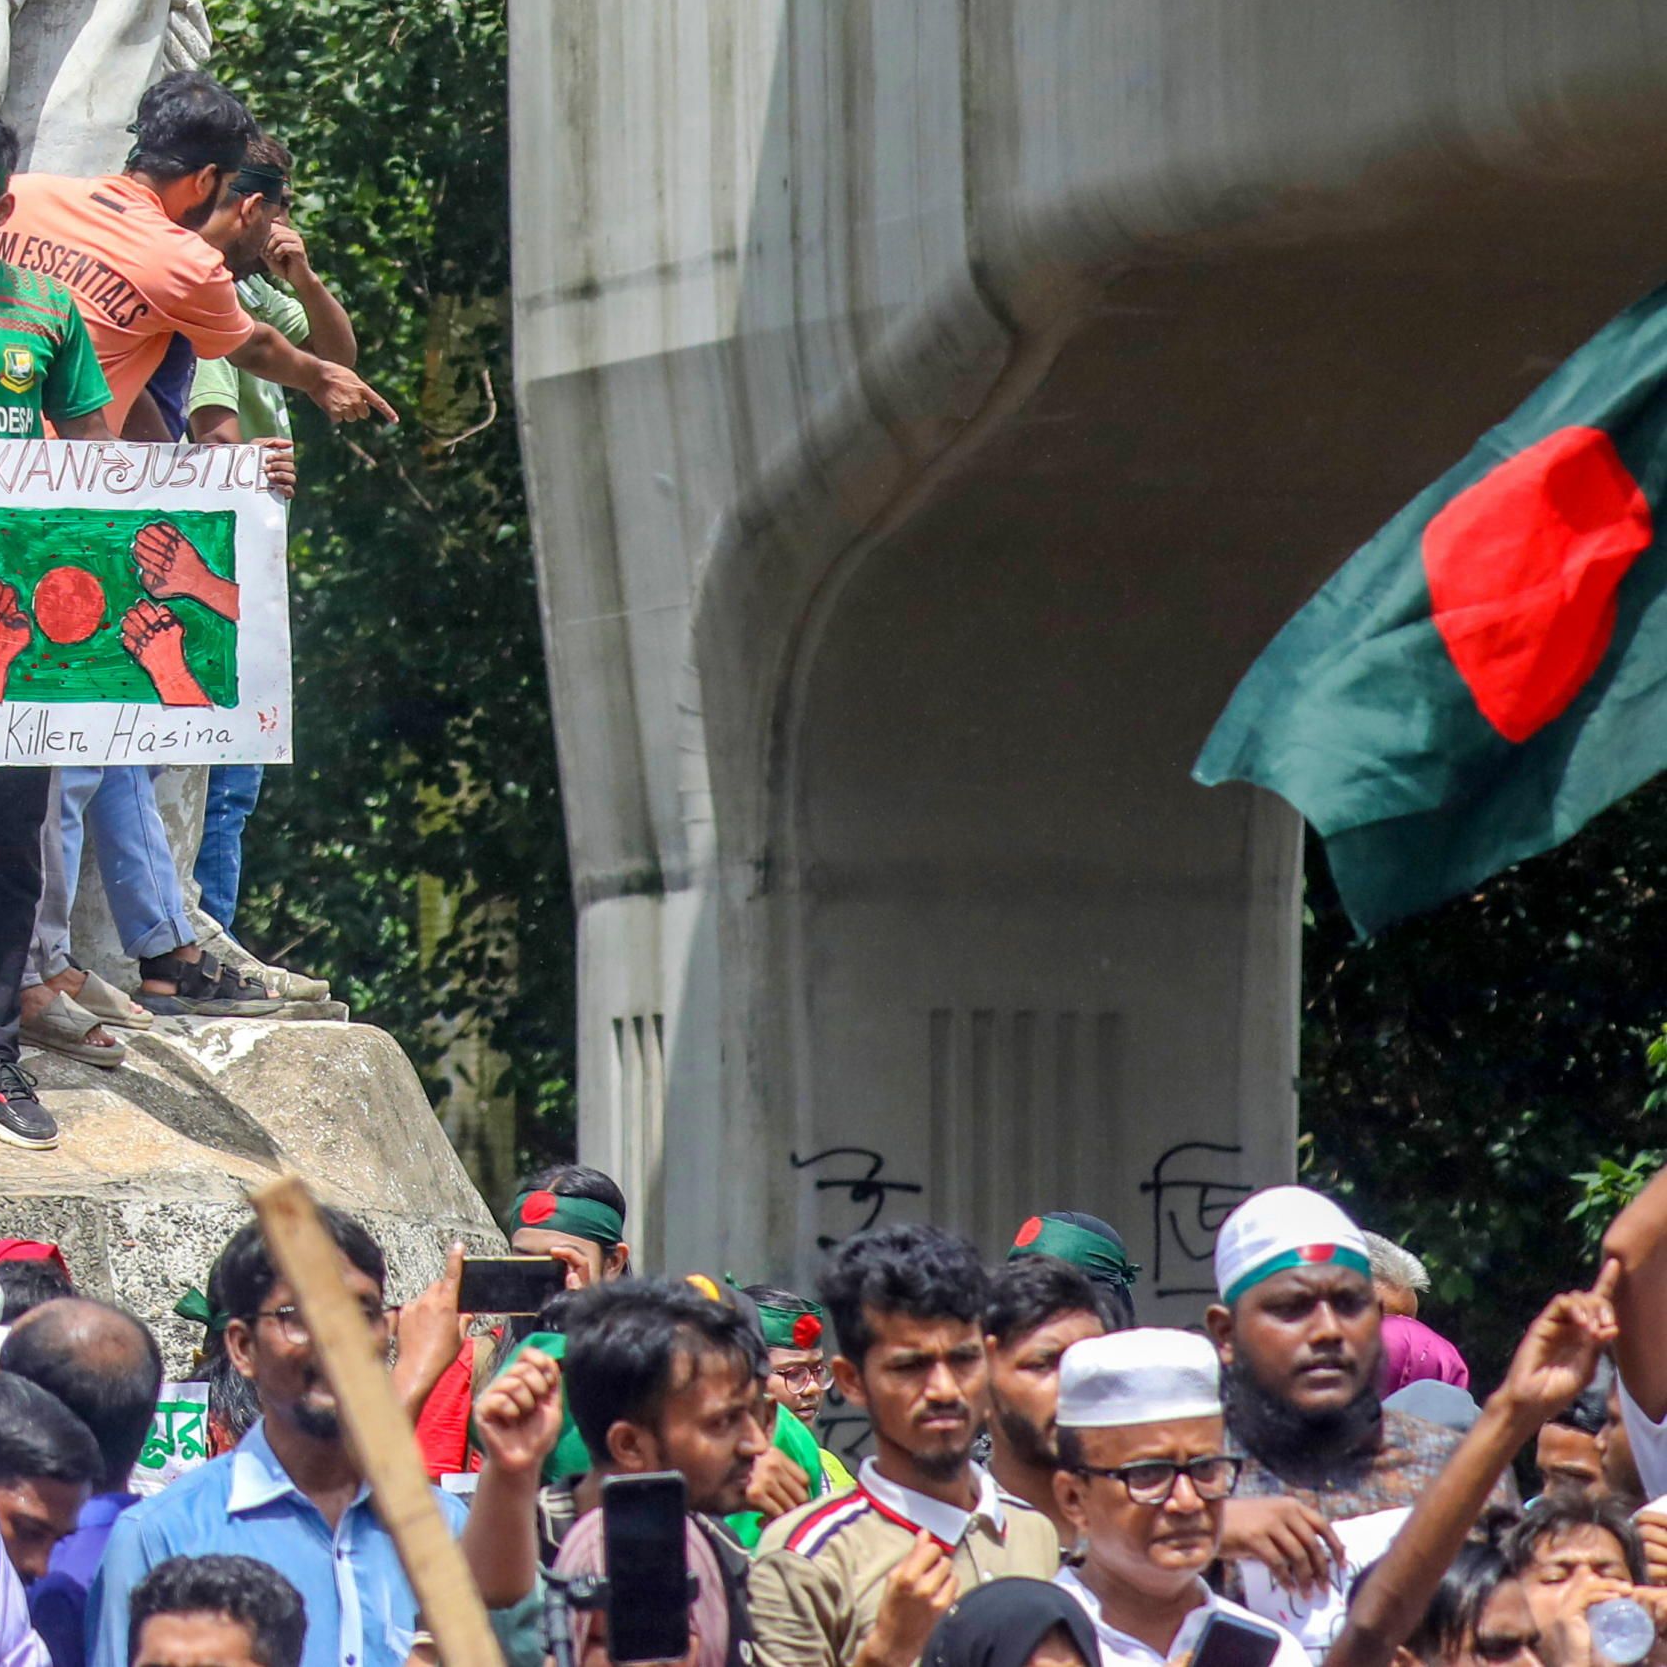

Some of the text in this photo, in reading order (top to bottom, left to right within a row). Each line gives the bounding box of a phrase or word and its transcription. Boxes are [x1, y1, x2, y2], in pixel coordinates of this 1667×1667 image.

[19, 235, 149, 328] ESSENTIALS
[105, 442, 277, 494] JUSTICE
[104, 704, 235, 761] Hasina
